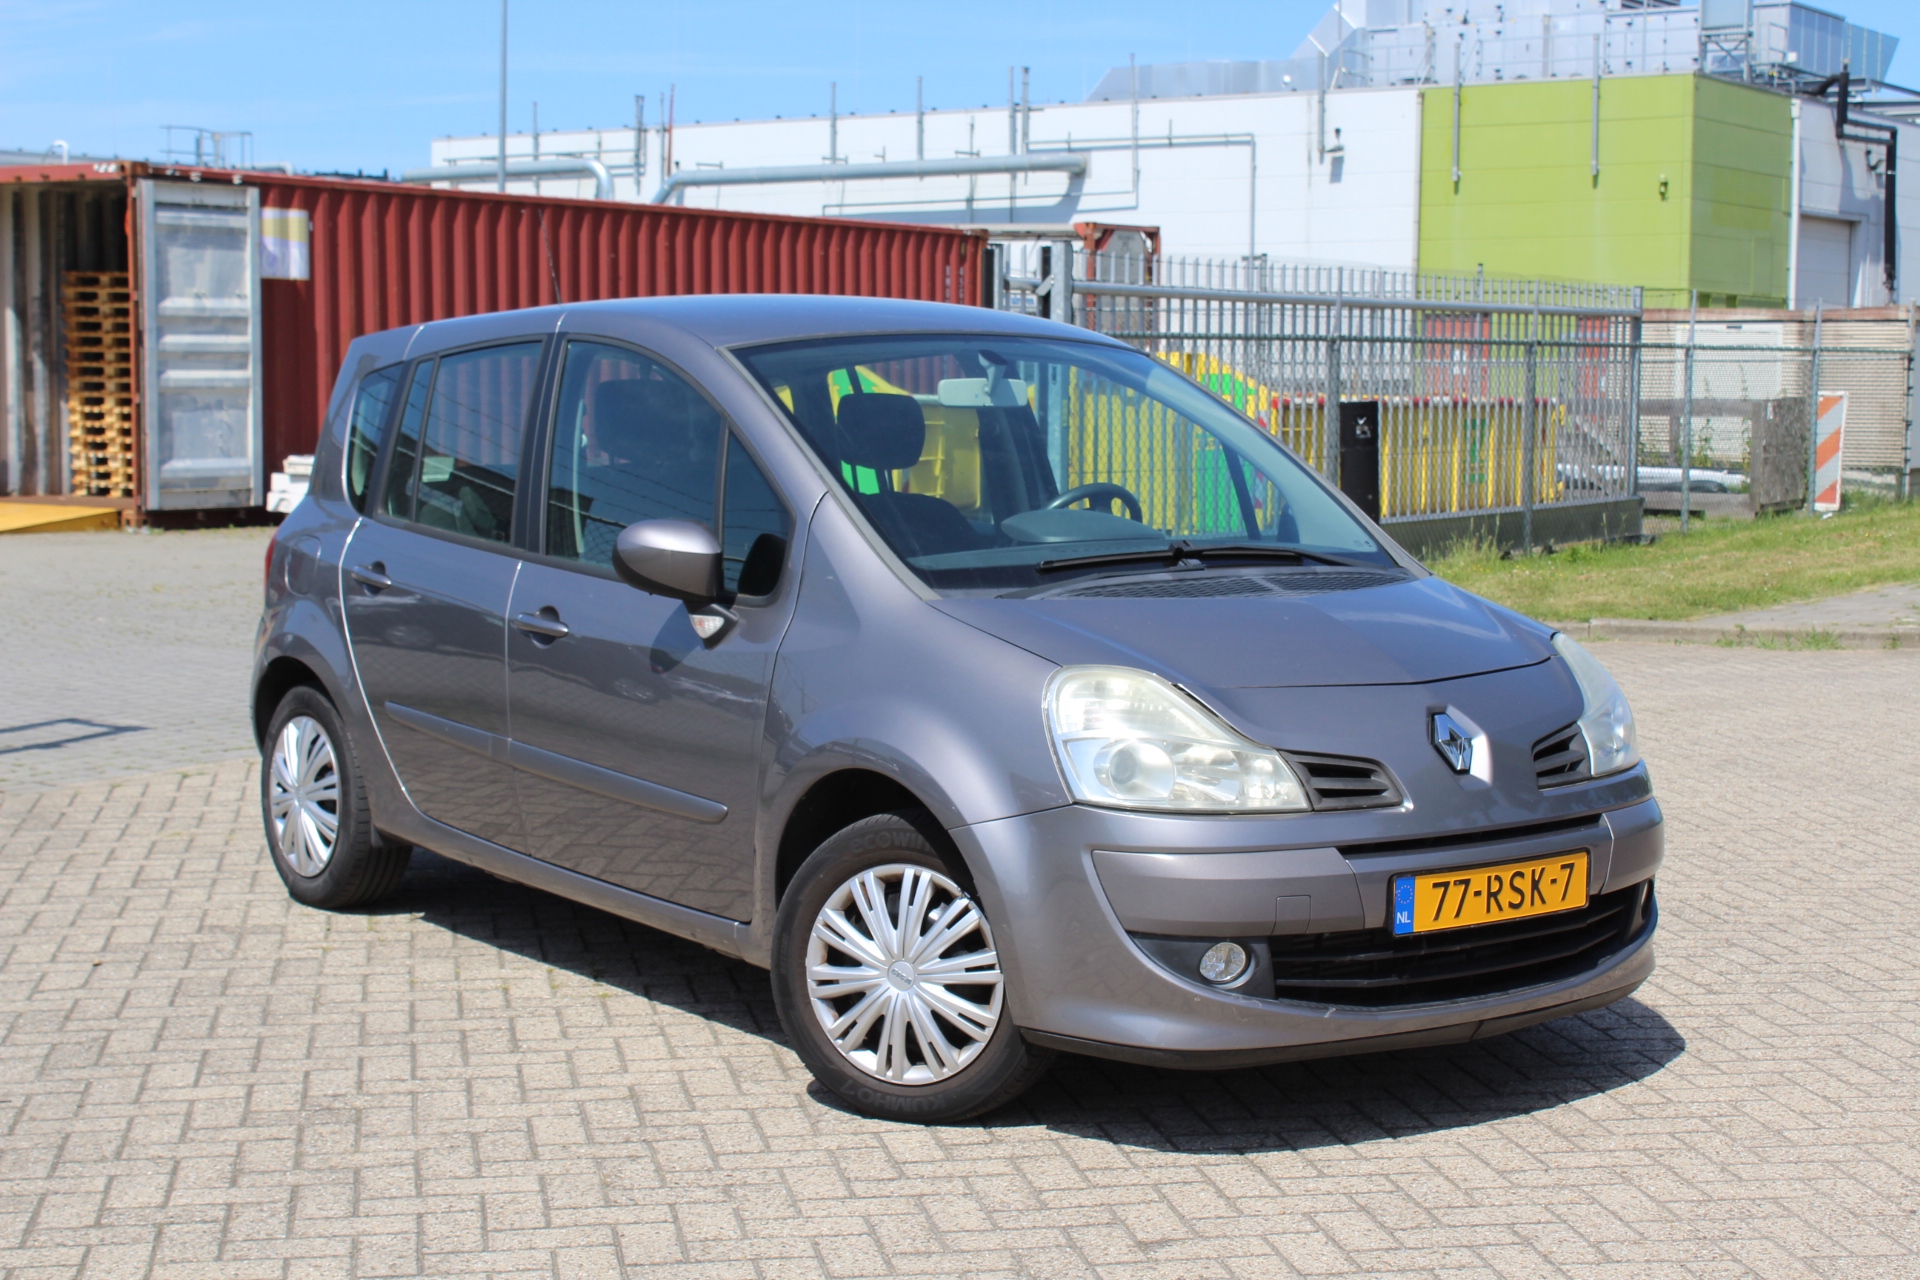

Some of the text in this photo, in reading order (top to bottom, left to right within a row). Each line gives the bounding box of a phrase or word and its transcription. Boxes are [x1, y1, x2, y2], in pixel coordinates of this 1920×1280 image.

[1431, 862, 1575, 922] 77-RSK-7
[1396, 911, 1411, 924] NL
[857, 1087, 947, 1113] KUMHO
